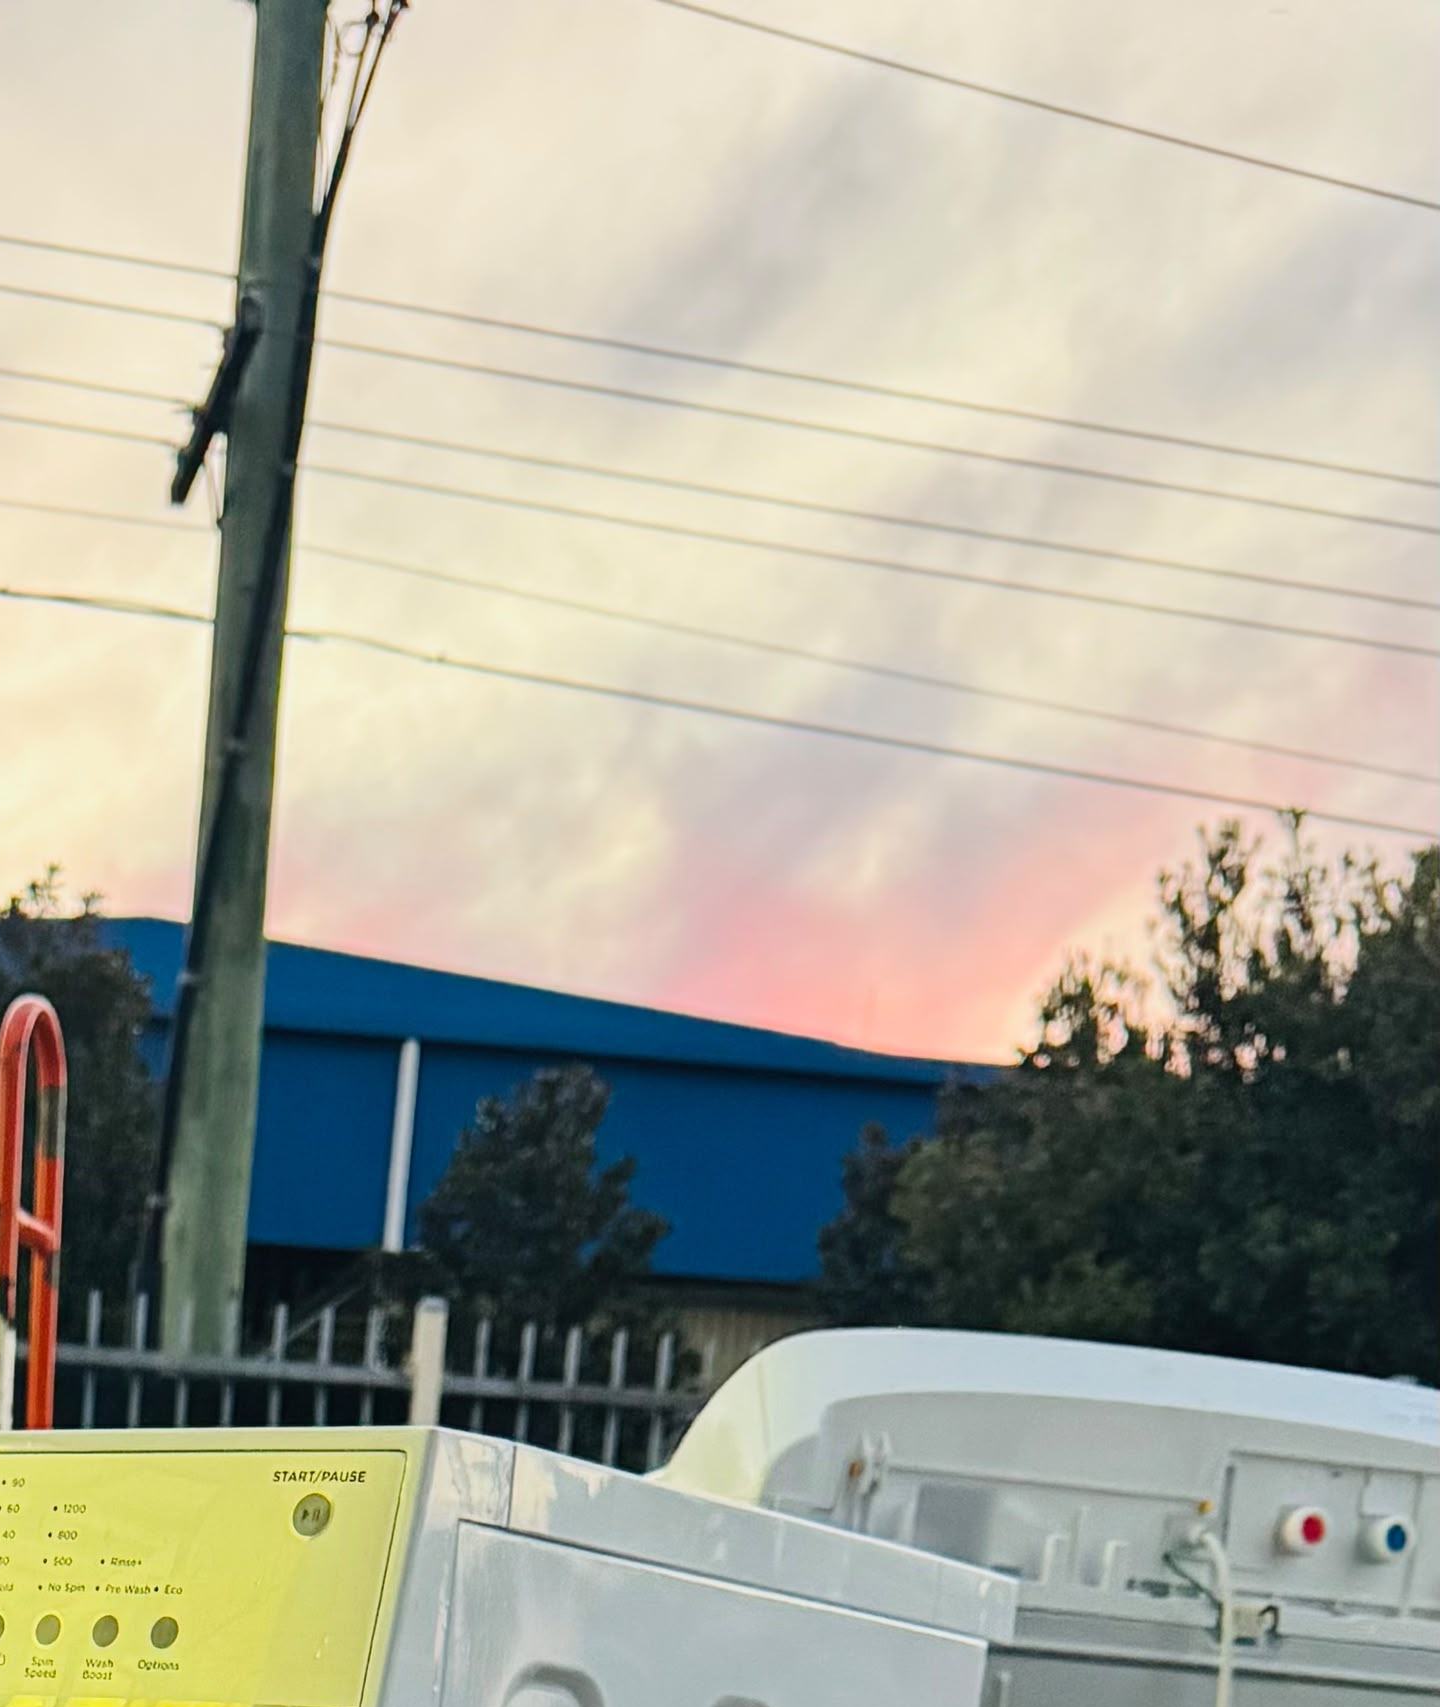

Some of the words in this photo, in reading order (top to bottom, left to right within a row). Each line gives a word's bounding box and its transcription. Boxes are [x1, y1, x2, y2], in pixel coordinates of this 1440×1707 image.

[12, 1477, 26, 1487] 90
[272, 1470, 367, 1484] START/PAUSE
[6, 1503, 20, 1514] 60
[63, 1504, 87, 1514] 1200
[2, 1530, 16, 1539] 40
[48, 1582, 62, 1592] No
[123, 1584, 151, 1595] Wash
[164, 1584, 183, 1595] Eco
